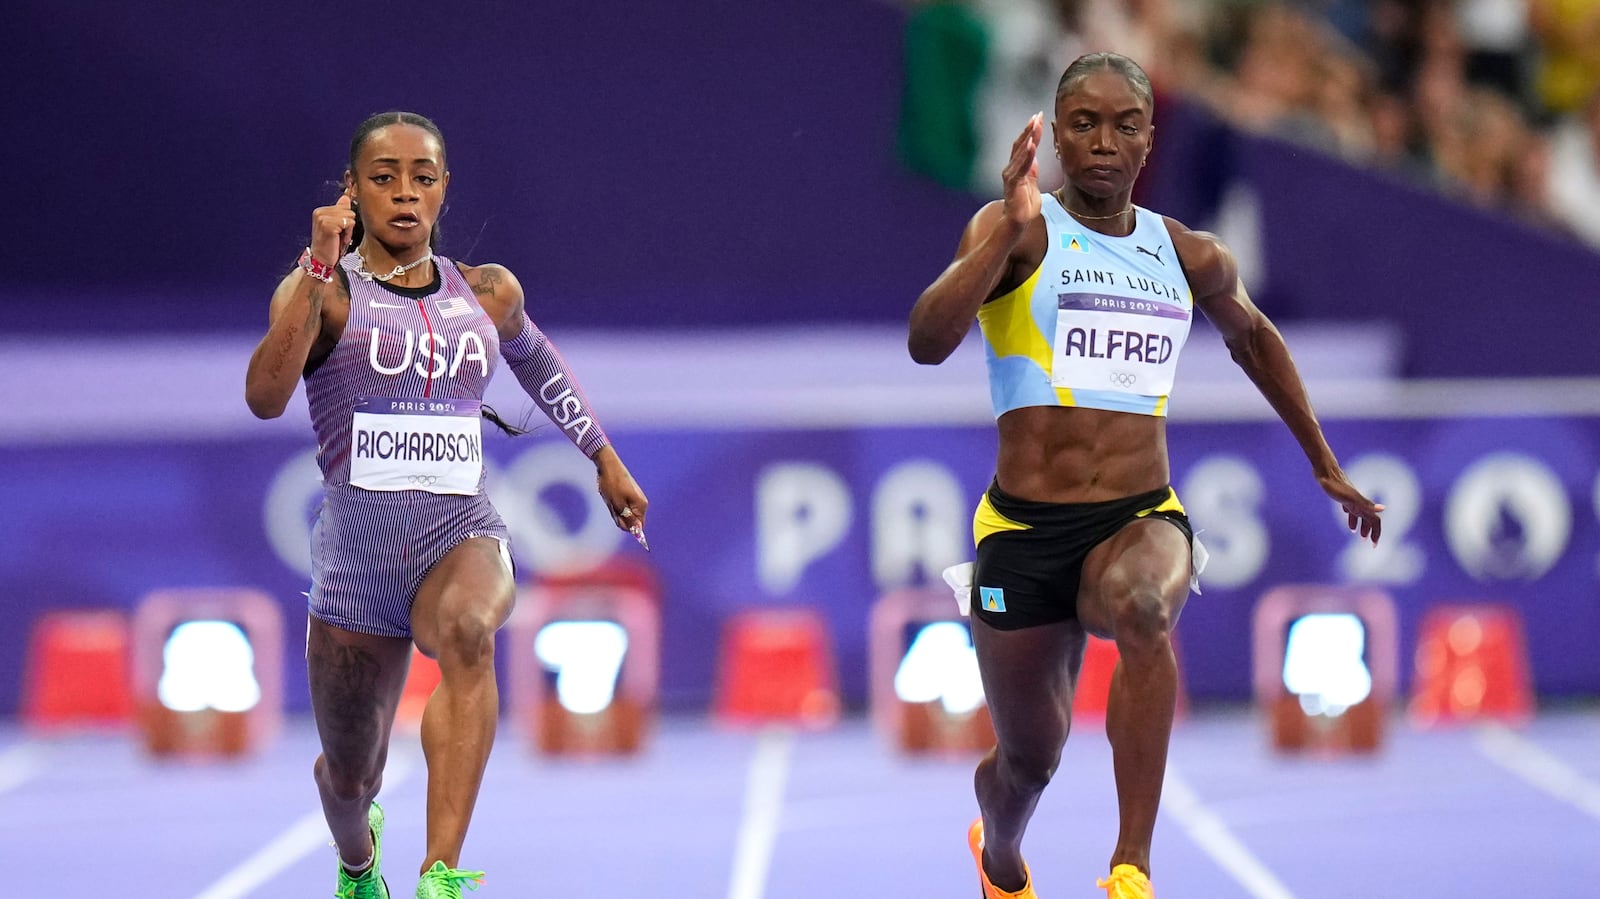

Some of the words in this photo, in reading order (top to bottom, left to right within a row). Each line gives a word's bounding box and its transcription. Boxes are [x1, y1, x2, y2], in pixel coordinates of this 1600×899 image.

[1061, 269, 1115, 286] SAINT
[1126, 275, 1182, 304] LUCIA
[1094, 297, 1127, 309] PARIS
[1129, 302, 1159, 312] 2024
[369, 327, 488, 379] USA
[1065, 327, 1173, 365] ALFRED
[391, 401, 426, 411] PARIS
[429, 402, 456, 414] 2024
[540, 372, 593, 446] USA
[357, 430, 480, 463] RICHARDSON
